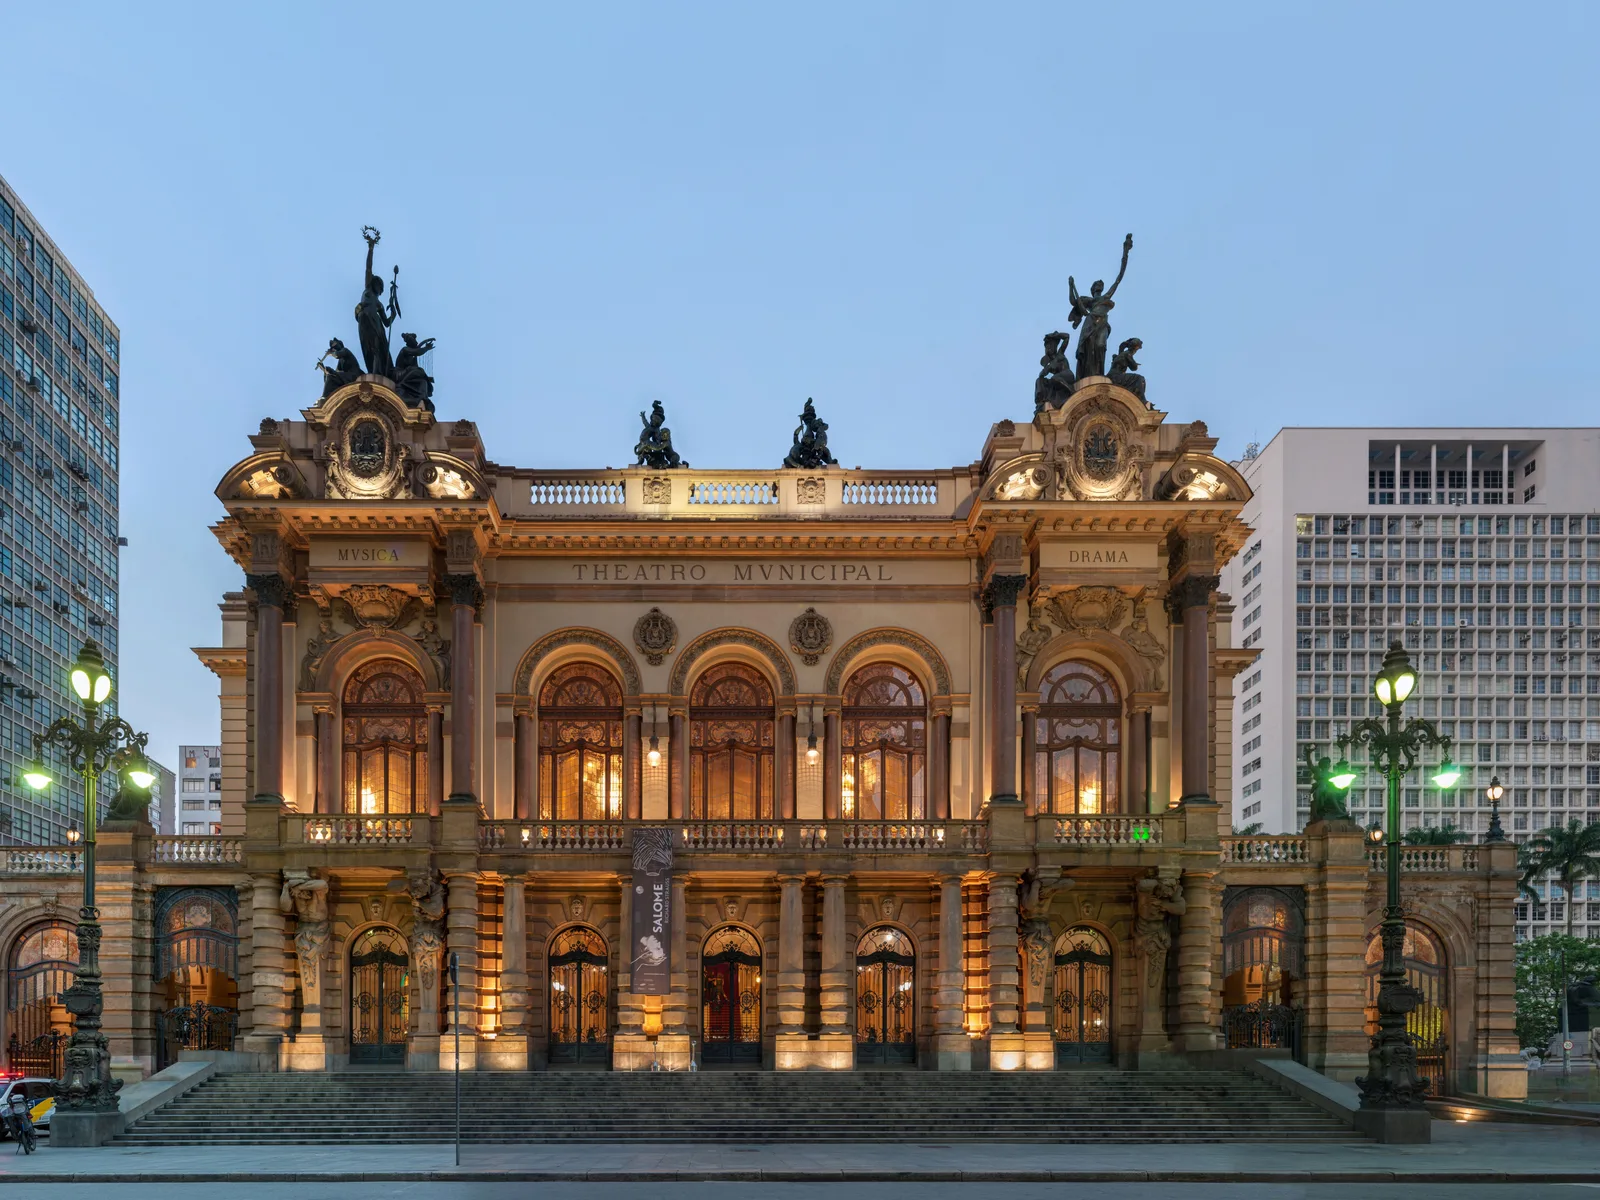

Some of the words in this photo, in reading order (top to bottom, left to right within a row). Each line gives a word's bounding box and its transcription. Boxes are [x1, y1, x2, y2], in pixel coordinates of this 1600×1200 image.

[338, 548, 399, 561] MVSICA
[1069, 550, 1129, 563] DRAMA
[572, 563, 707, 581] THEATRO
[733, 563, 894, 581] MVNICIPAL
[652, 883, 663, 933] SALOME
